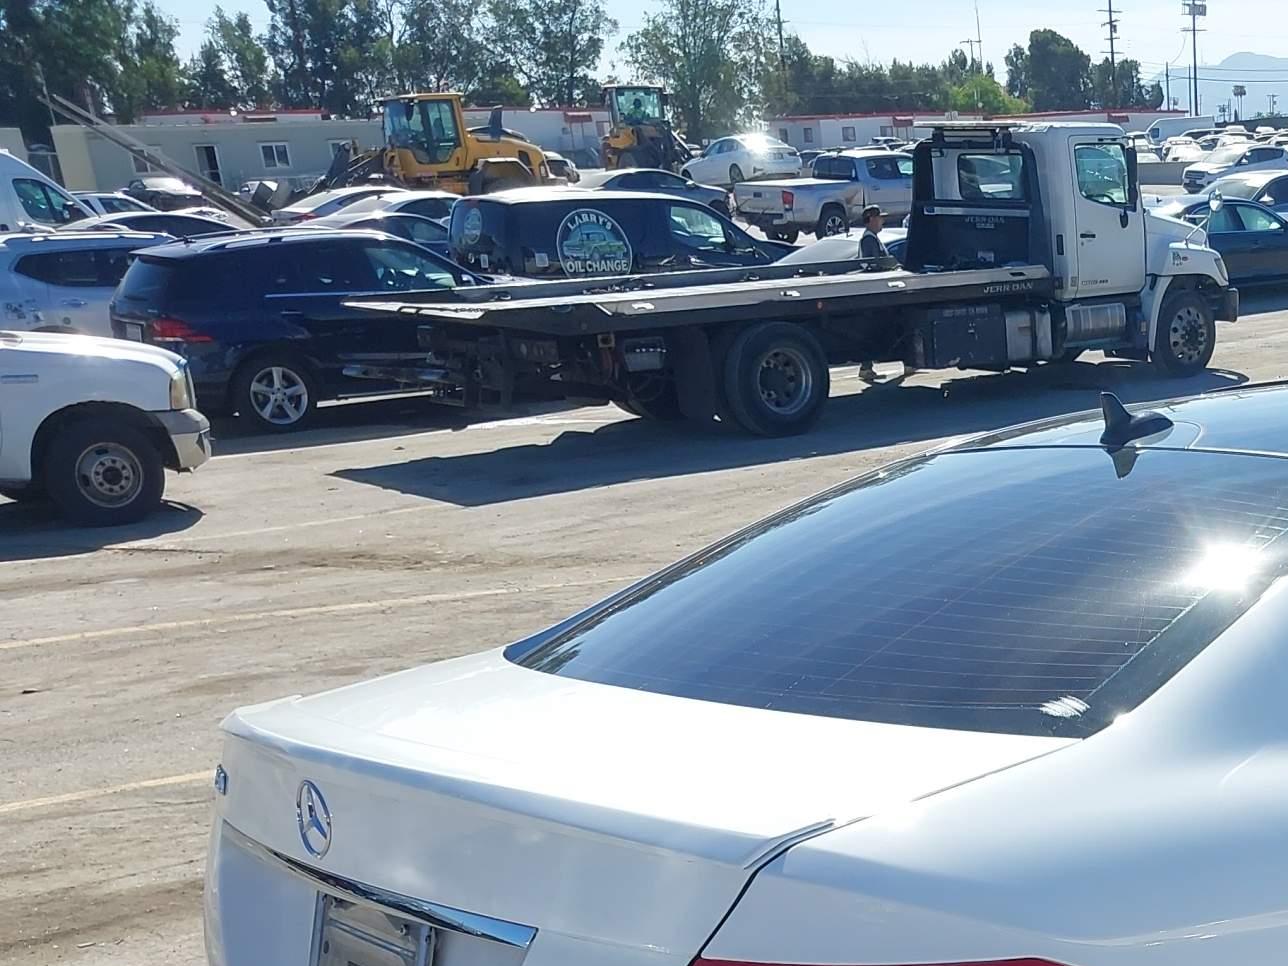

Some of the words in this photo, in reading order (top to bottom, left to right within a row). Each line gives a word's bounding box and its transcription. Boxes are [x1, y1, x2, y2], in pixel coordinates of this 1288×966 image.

[567, 213, 613, 231] LARRY'S
[566, 261, 586, 273] OIL
[586, 260, 629, 272] CHANGE
